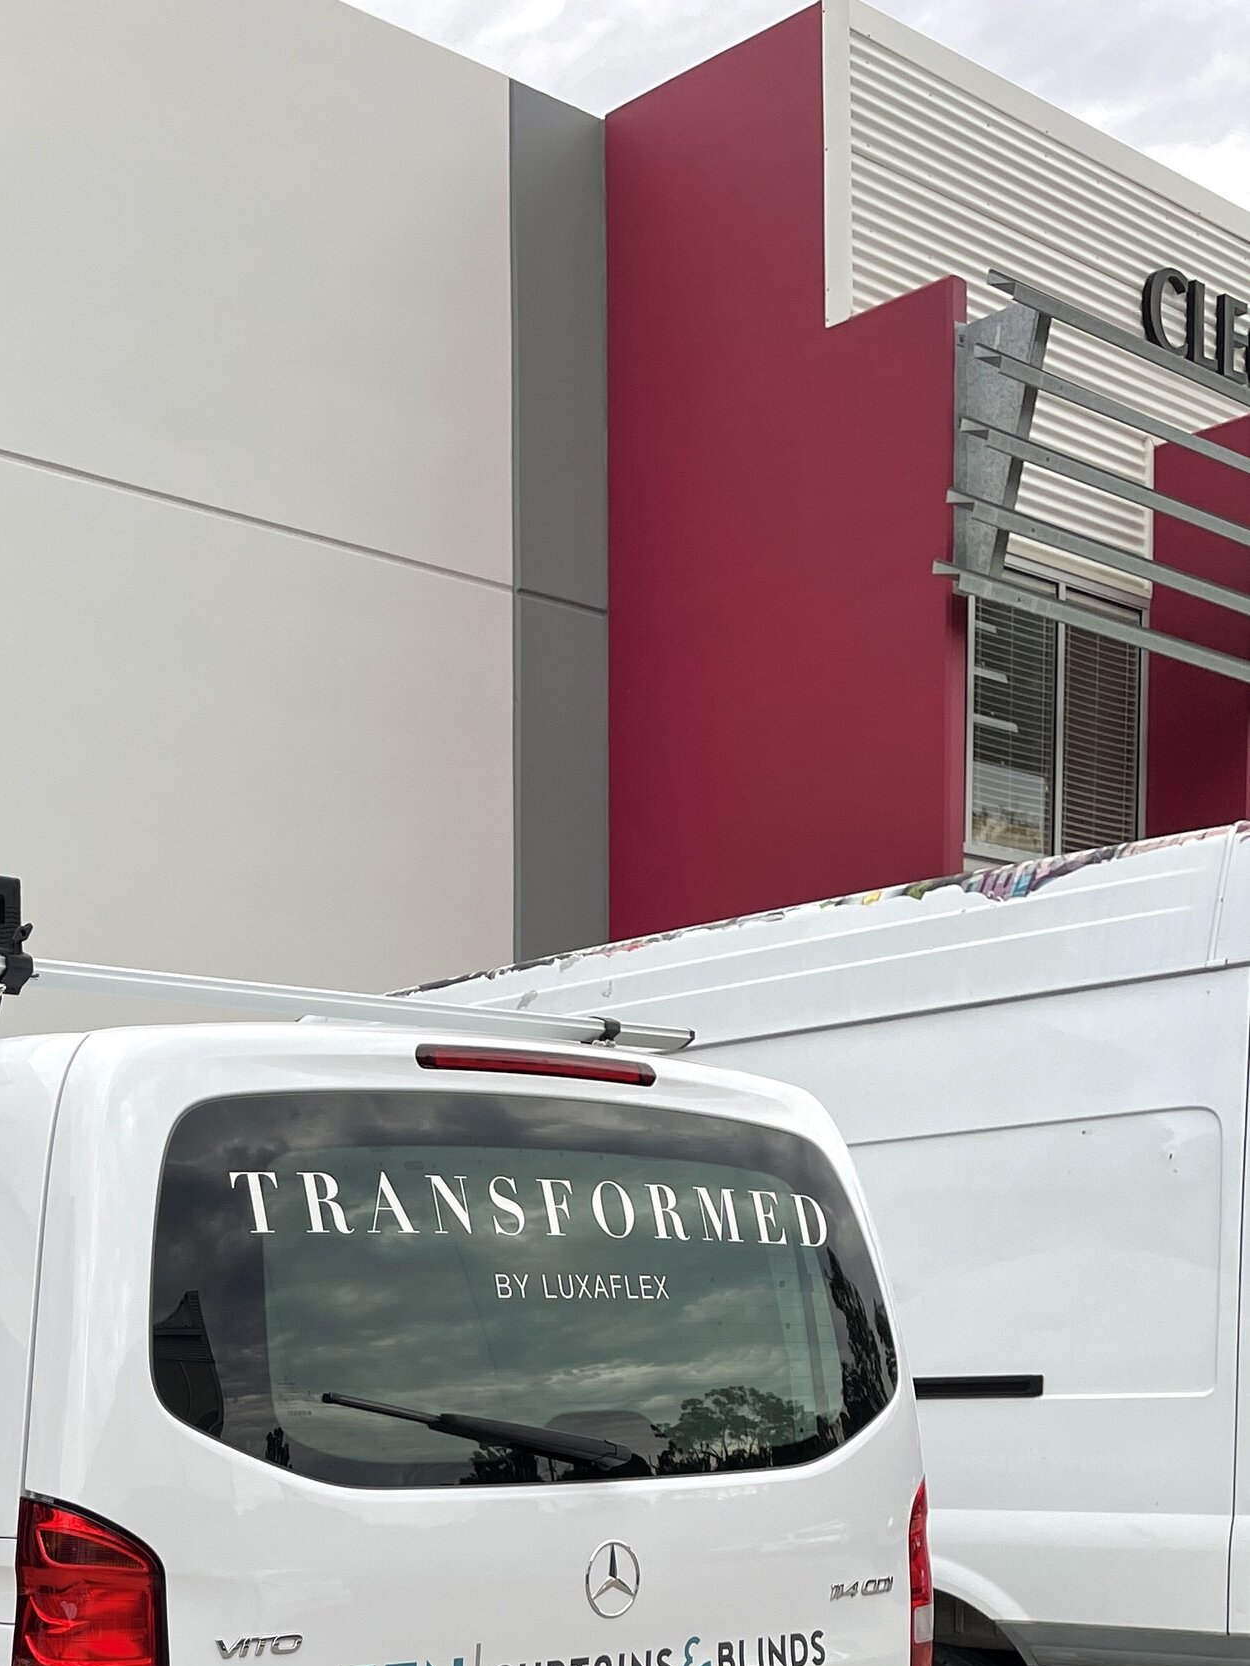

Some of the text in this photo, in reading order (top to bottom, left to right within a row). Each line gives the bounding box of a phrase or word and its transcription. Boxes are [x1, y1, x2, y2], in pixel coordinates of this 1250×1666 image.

[1141, 267, 1250, 388] CLE
[229, 1170, 829, 1247] TRANSFORMED
[494, 1273, 669, 1300] BY LUXAFLEX
[215, 1633, 304, 1659] VITO
